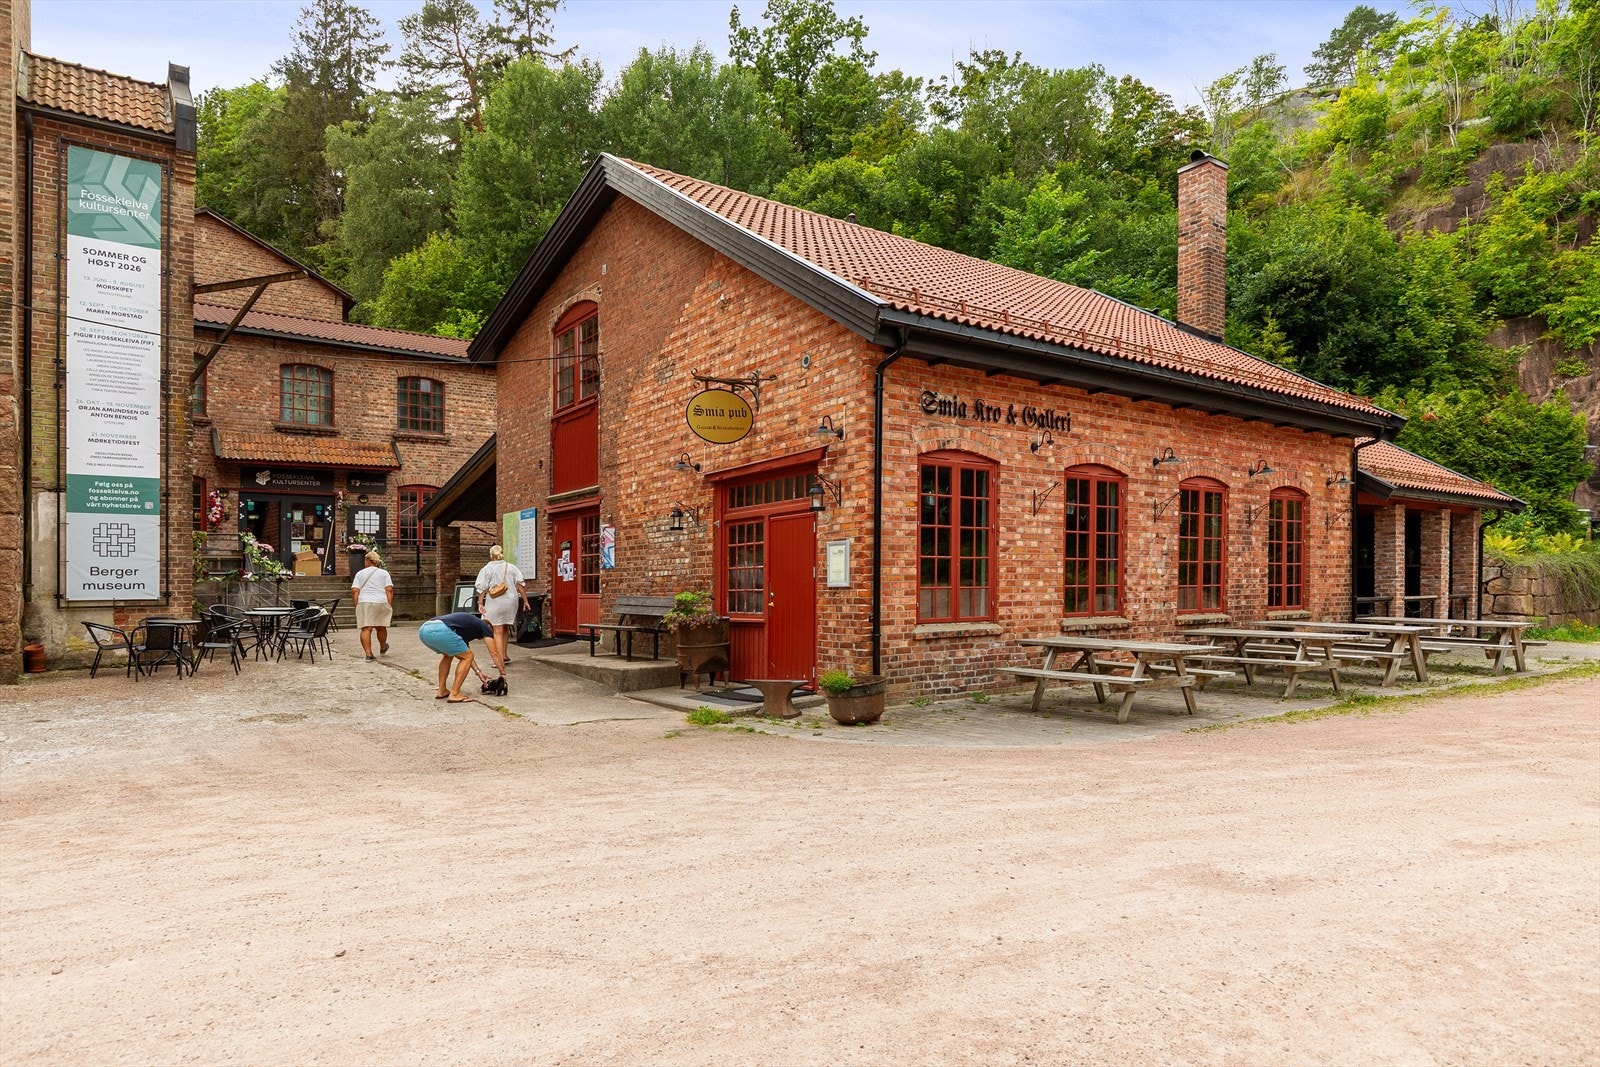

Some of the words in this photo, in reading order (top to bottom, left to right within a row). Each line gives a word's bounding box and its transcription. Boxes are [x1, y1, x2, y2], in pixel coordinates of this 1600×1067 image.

[81, 189, 148, 210] Fossekleiva
[80, 199, 150, 220] kultursenter
[83, 248, 129, 260] SOMMER
[88, 258, 115, 267] HØST
[118, 263, 141, 272] 2026
[96, 284, 133, 292] MORSKIPET
[98, 336, 139, 344] FOSSEKLEIVA
[693, 405, 724, 417] Smia
[729, 408, 747, 419] pub
[921, 391, 967, 418] Smia
[973, 399, 1001, 422] Kro
[1007, 404, 1017, 425] &
[1022, 406, 1071, 432] Galleri
[90, 567, 139, 579] Berger
